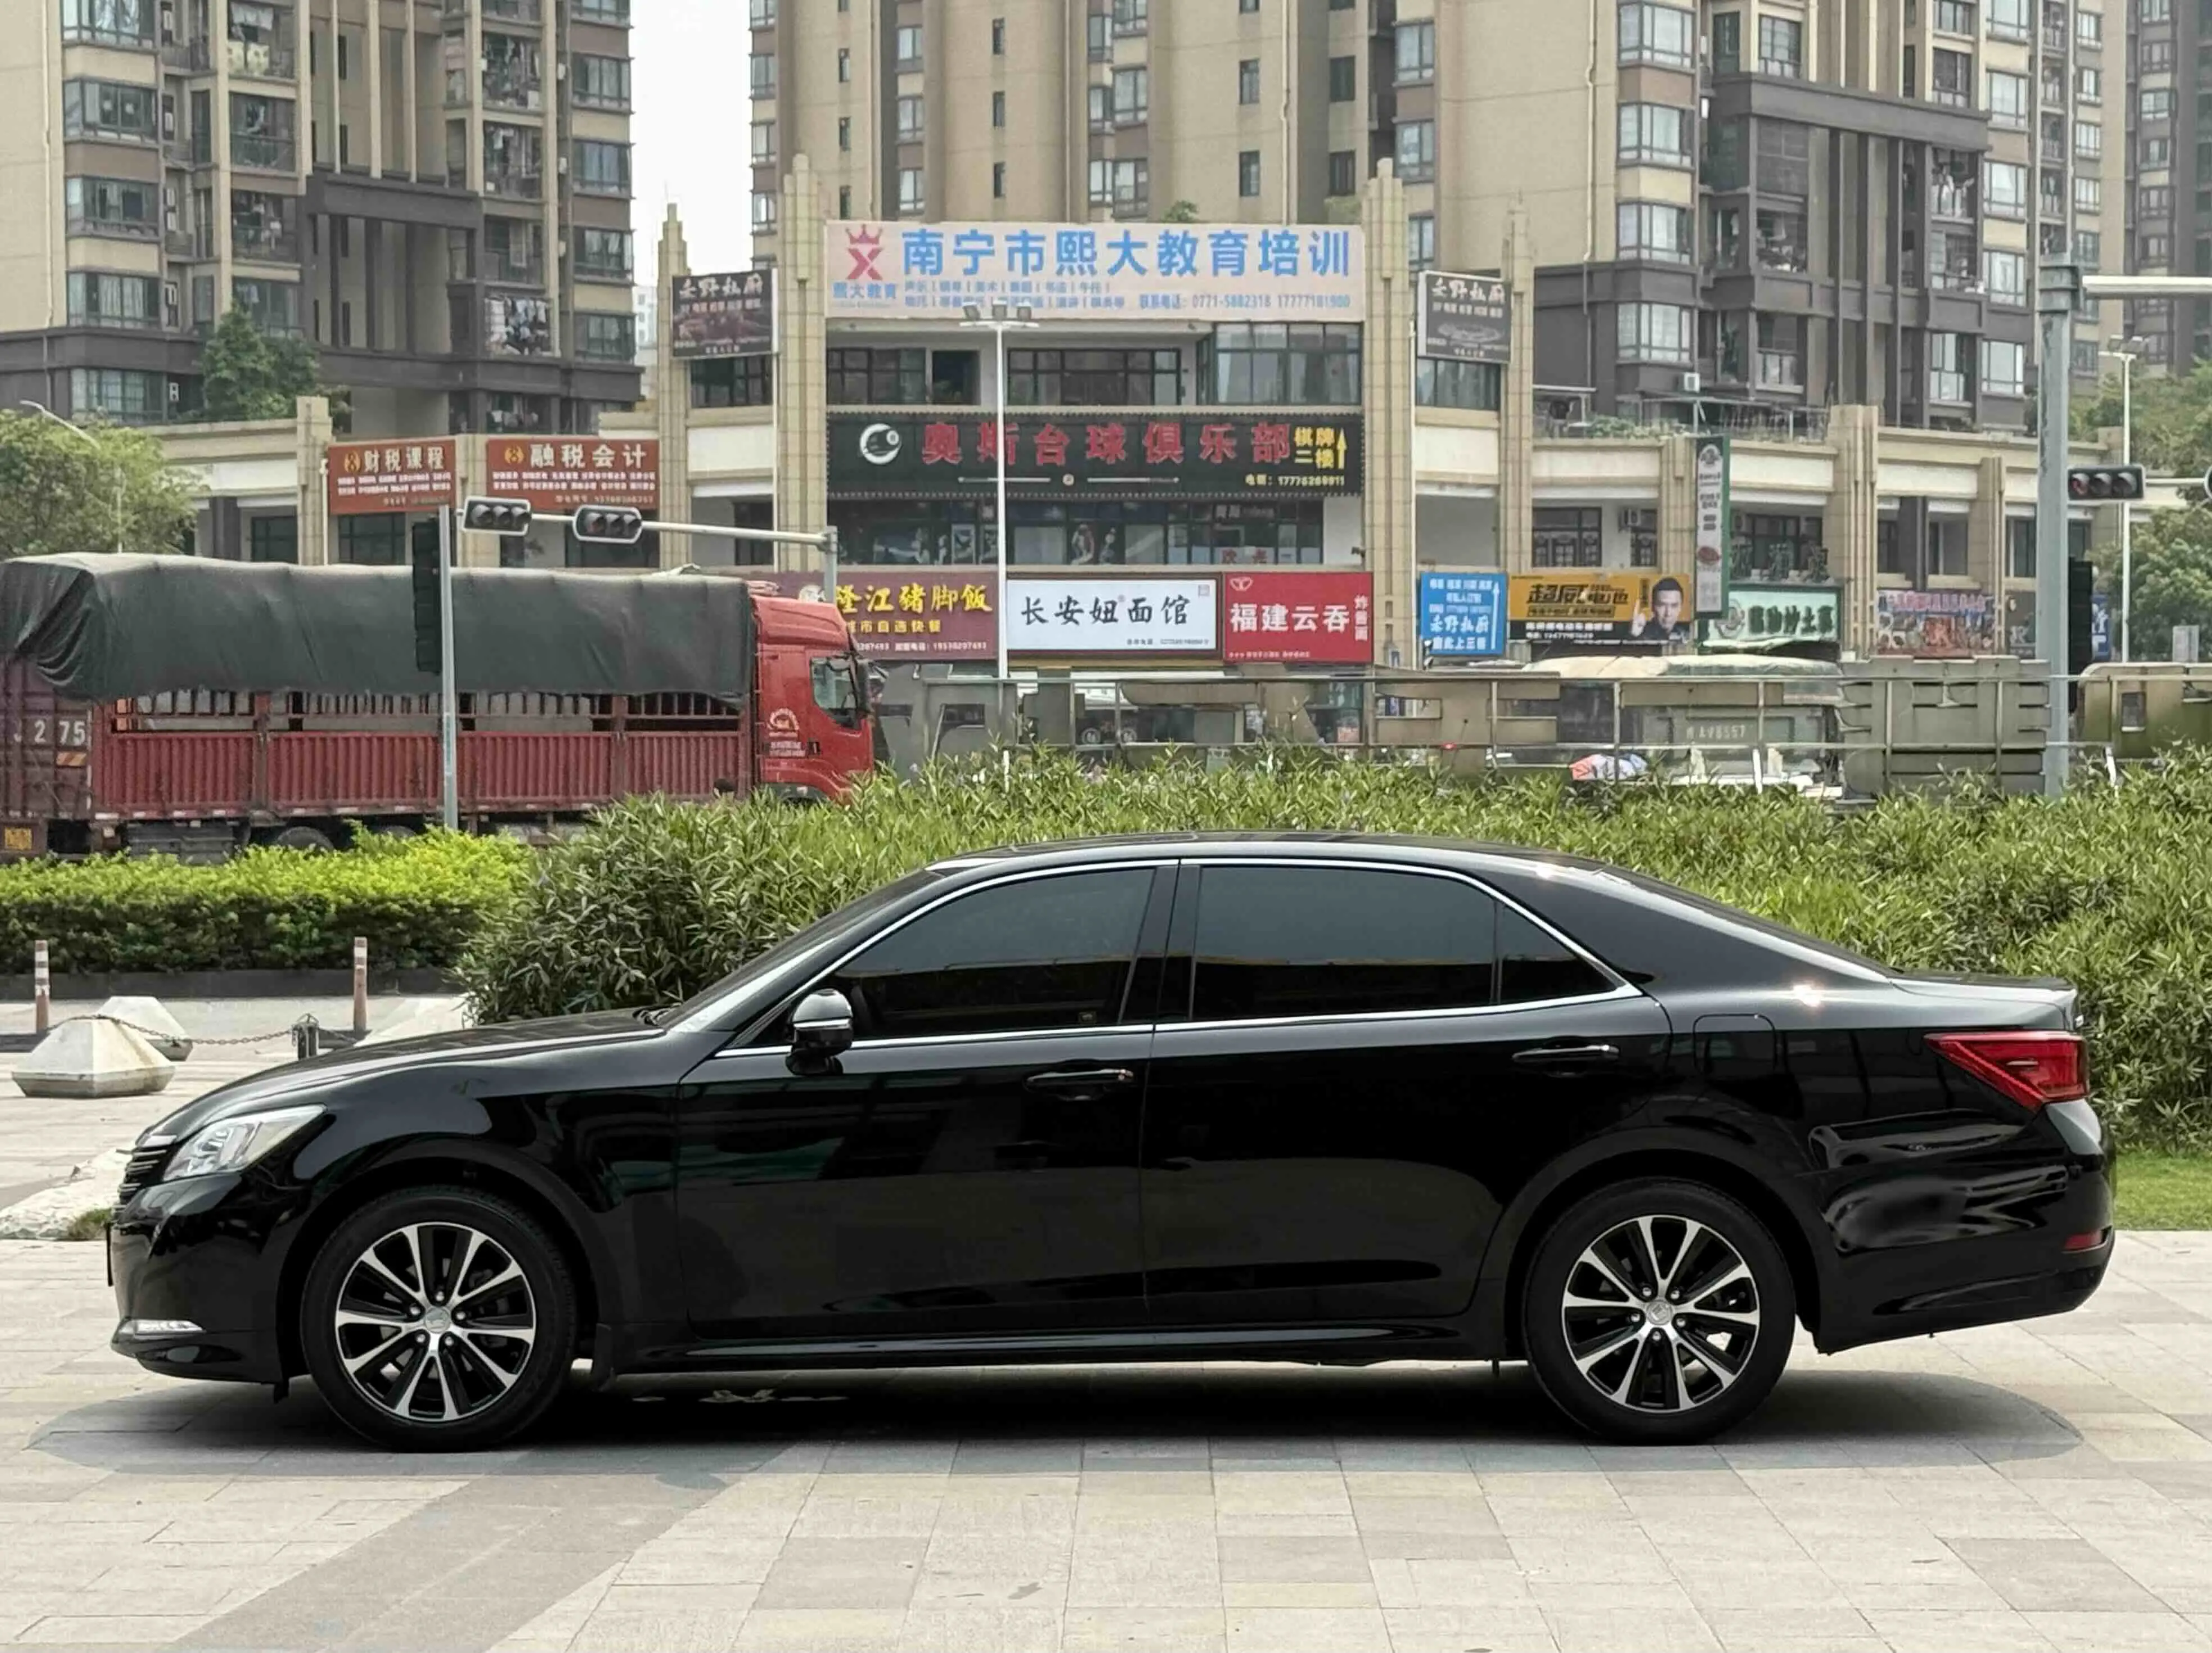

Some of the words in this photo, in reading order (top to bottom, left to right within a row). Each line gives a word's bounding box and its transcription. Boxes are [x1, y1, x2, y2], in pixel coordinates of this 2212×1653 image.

[902, 229, 1349, 277] 南宁市熙大教育培训
[531, 443, 647, 468] 融税会计
[922, 422, 1291, 465] 奥斯台球俱乐部
[1294, 449, 1335, 469] 二楼
[1021, 594, 1190, 625] 长安妞面馆
[1230, 603, 1350, 633] 福建云吞
